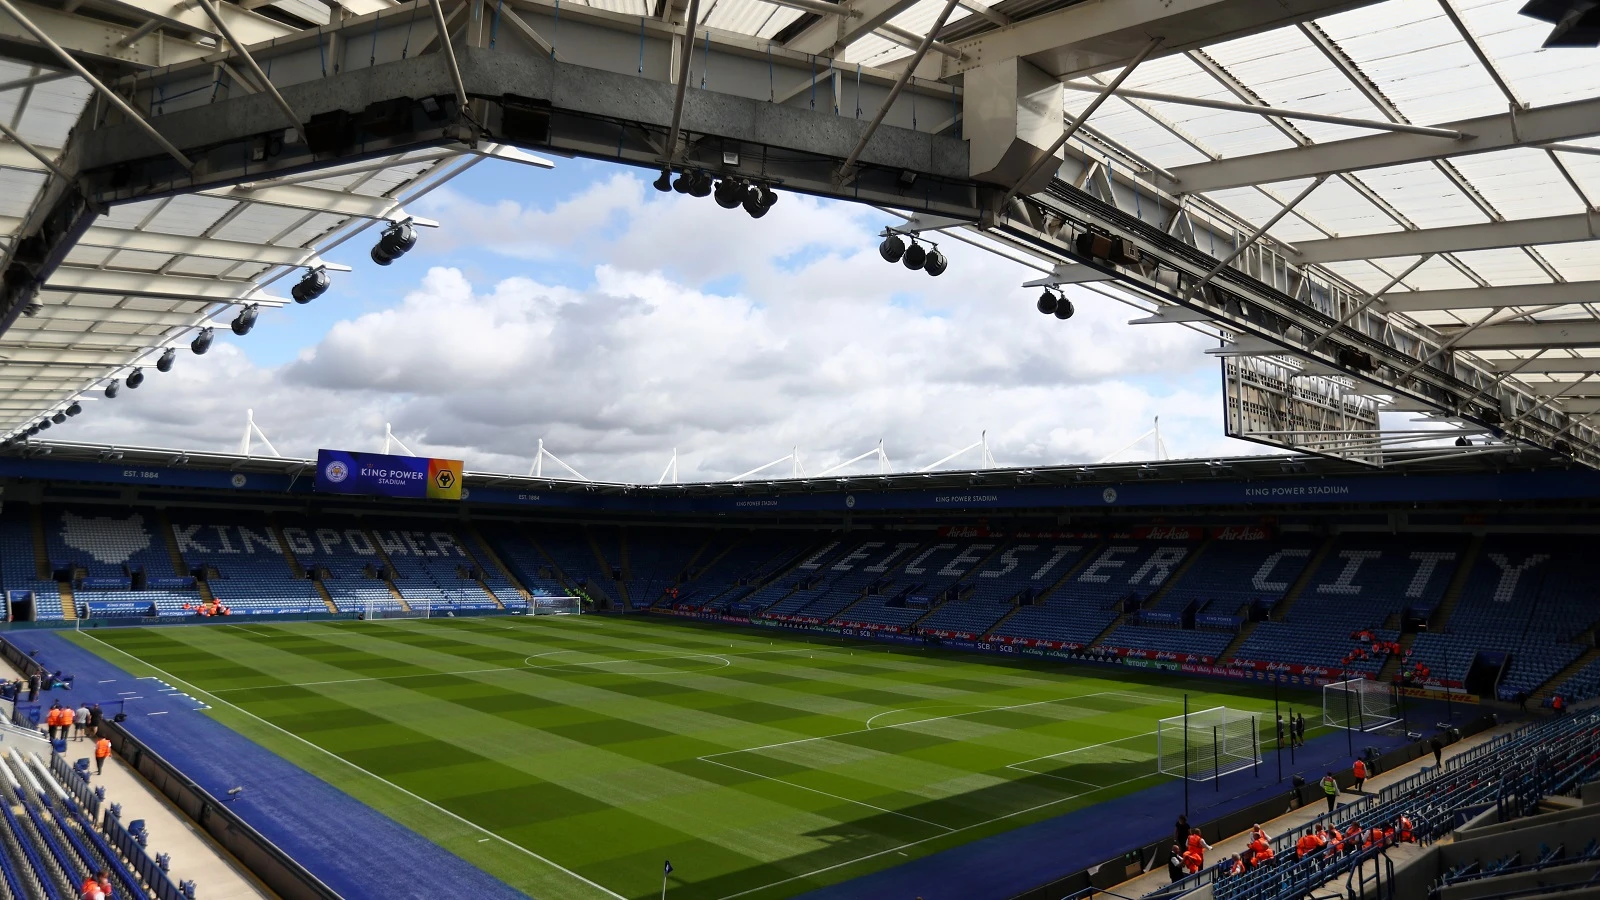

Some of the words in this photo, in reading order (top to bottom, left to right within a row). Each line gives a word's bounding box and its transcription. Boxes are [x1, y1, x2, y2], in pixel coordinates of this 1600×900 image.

[140, 471, 159, 480] 1884
[361, 468, 387, 478] KING
[389, 470, 424, 480] POWER
[378, 478, 406, 487] STADIUM
[1245, 488, 1269, 496] KING
[1271, 487, 1305, 495] POWER
[1308, 486, 1349, 495] STADIUM
[799, 541, 1188, 585] LEICESTER
[1252, 548, 1551, 602] CITY
[999, 645, 1013, 653] SCB
